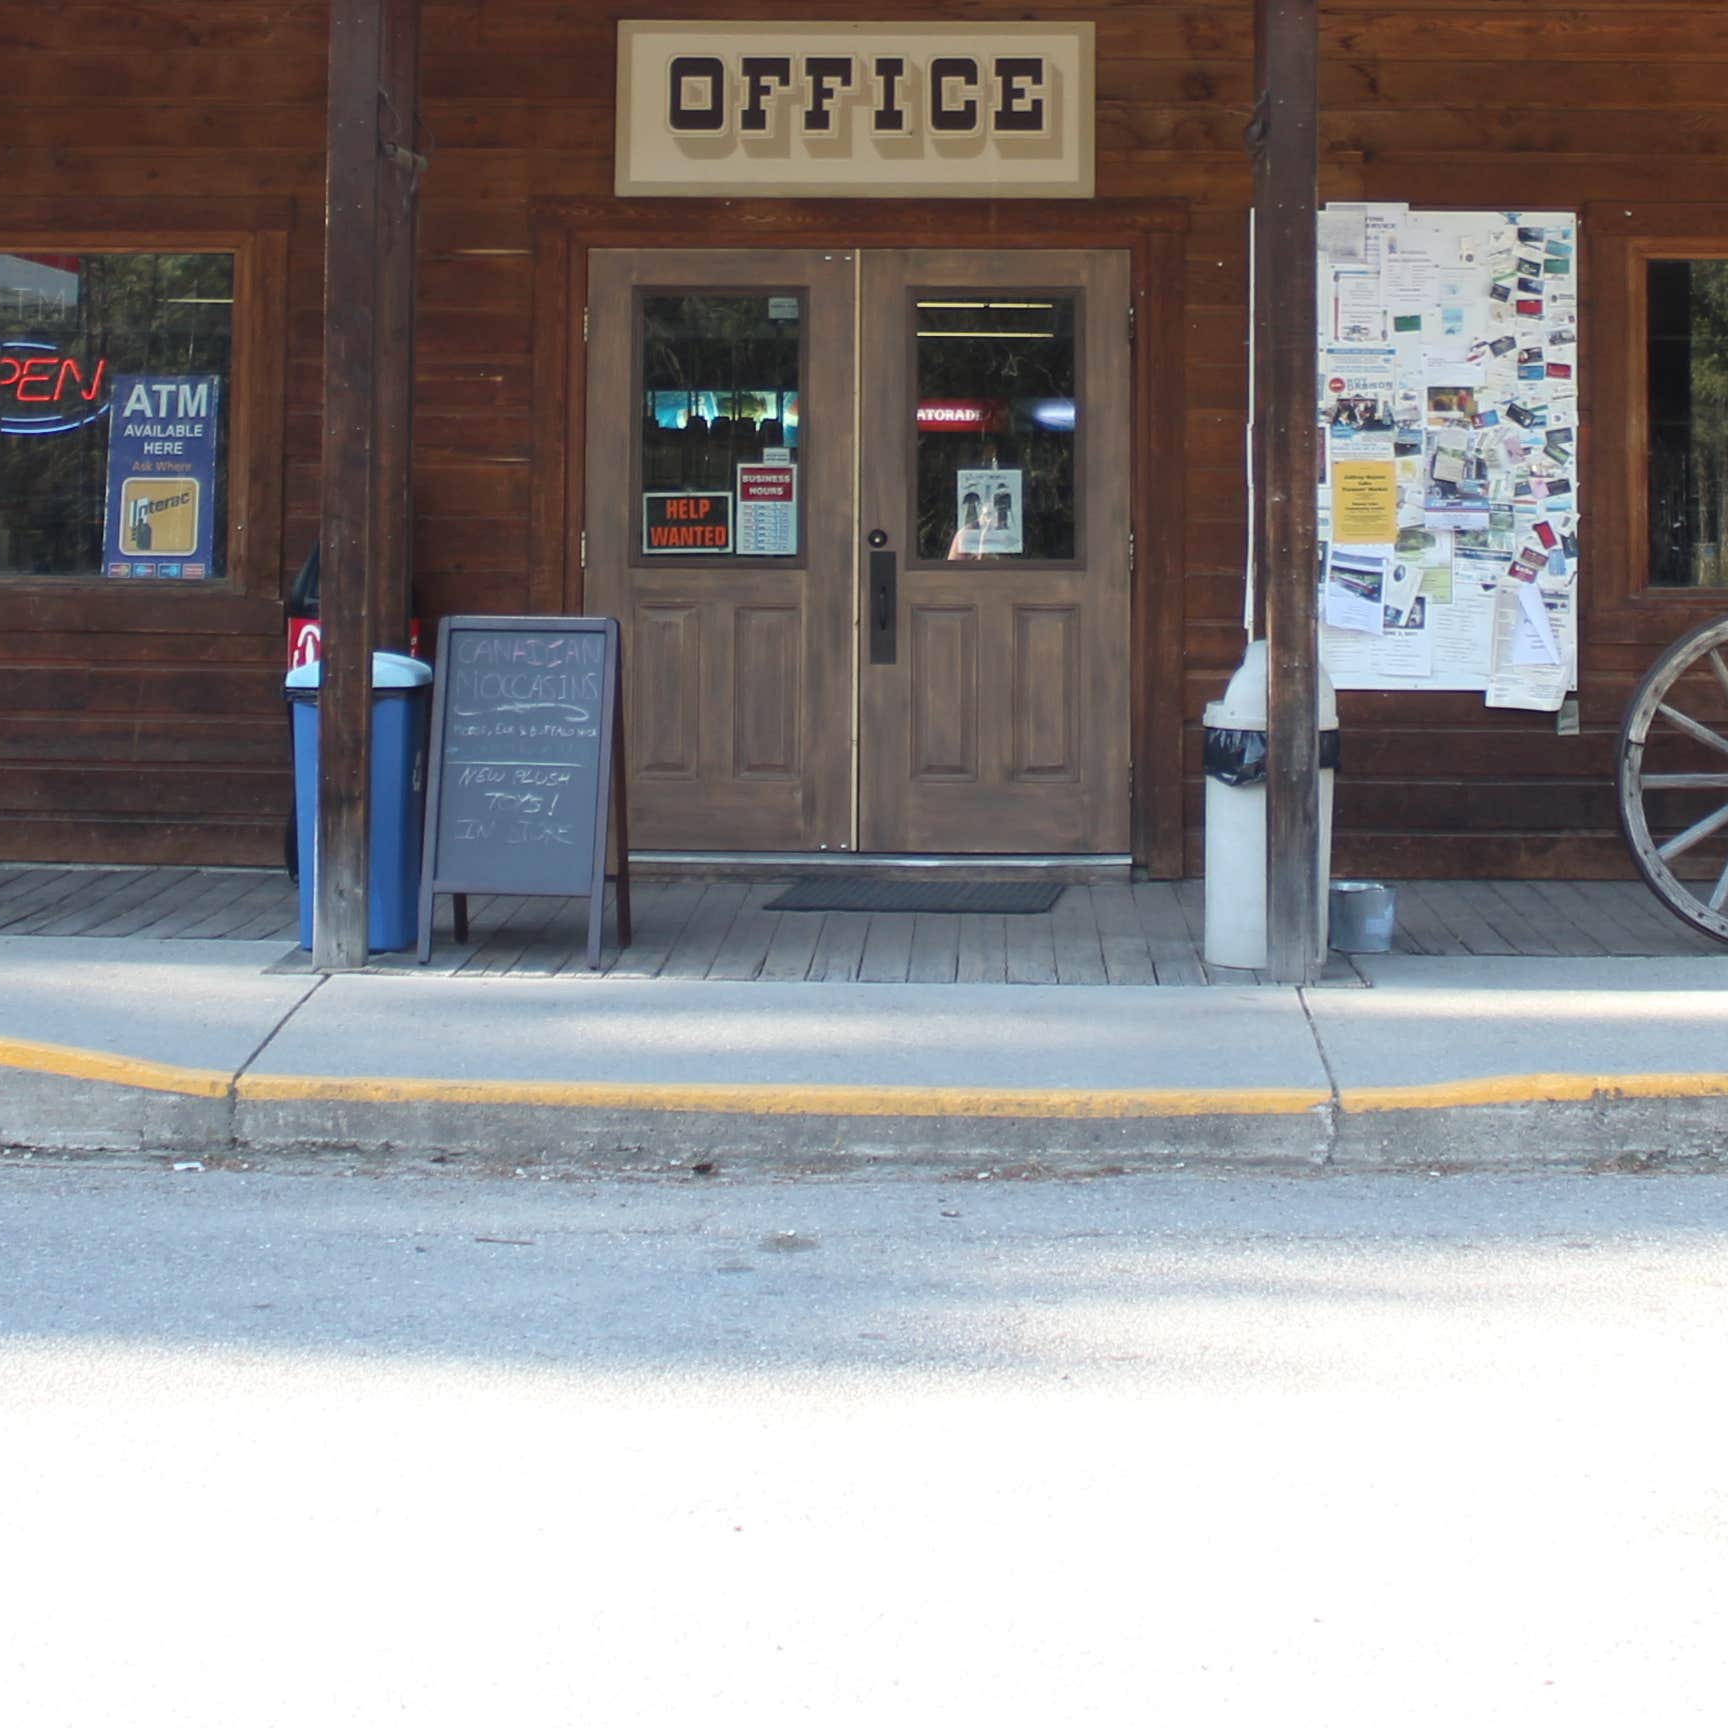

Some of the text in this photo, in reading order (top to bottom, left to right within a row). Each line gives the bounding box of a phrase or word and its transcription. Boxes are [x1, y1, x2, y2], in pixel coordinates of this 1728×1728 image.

[668, 55, 1046, 134] OFFICE
[122, 383, 209, 419] ATM
[916, 408, 985, 421] ATORADE
[123, 423, 204, 438] AVAILABLE
[143, 441, 184, 455] HERE
[131, 459, 193, 473] Ask Where
[741, 474, 791, 484] BUSINESS
[748, 486, 784, 496] HOURS
[665, 498, 711, 519] HELP
[649, 525, 727, 547] WANTED
[458, 767, 505, 786] NEW
